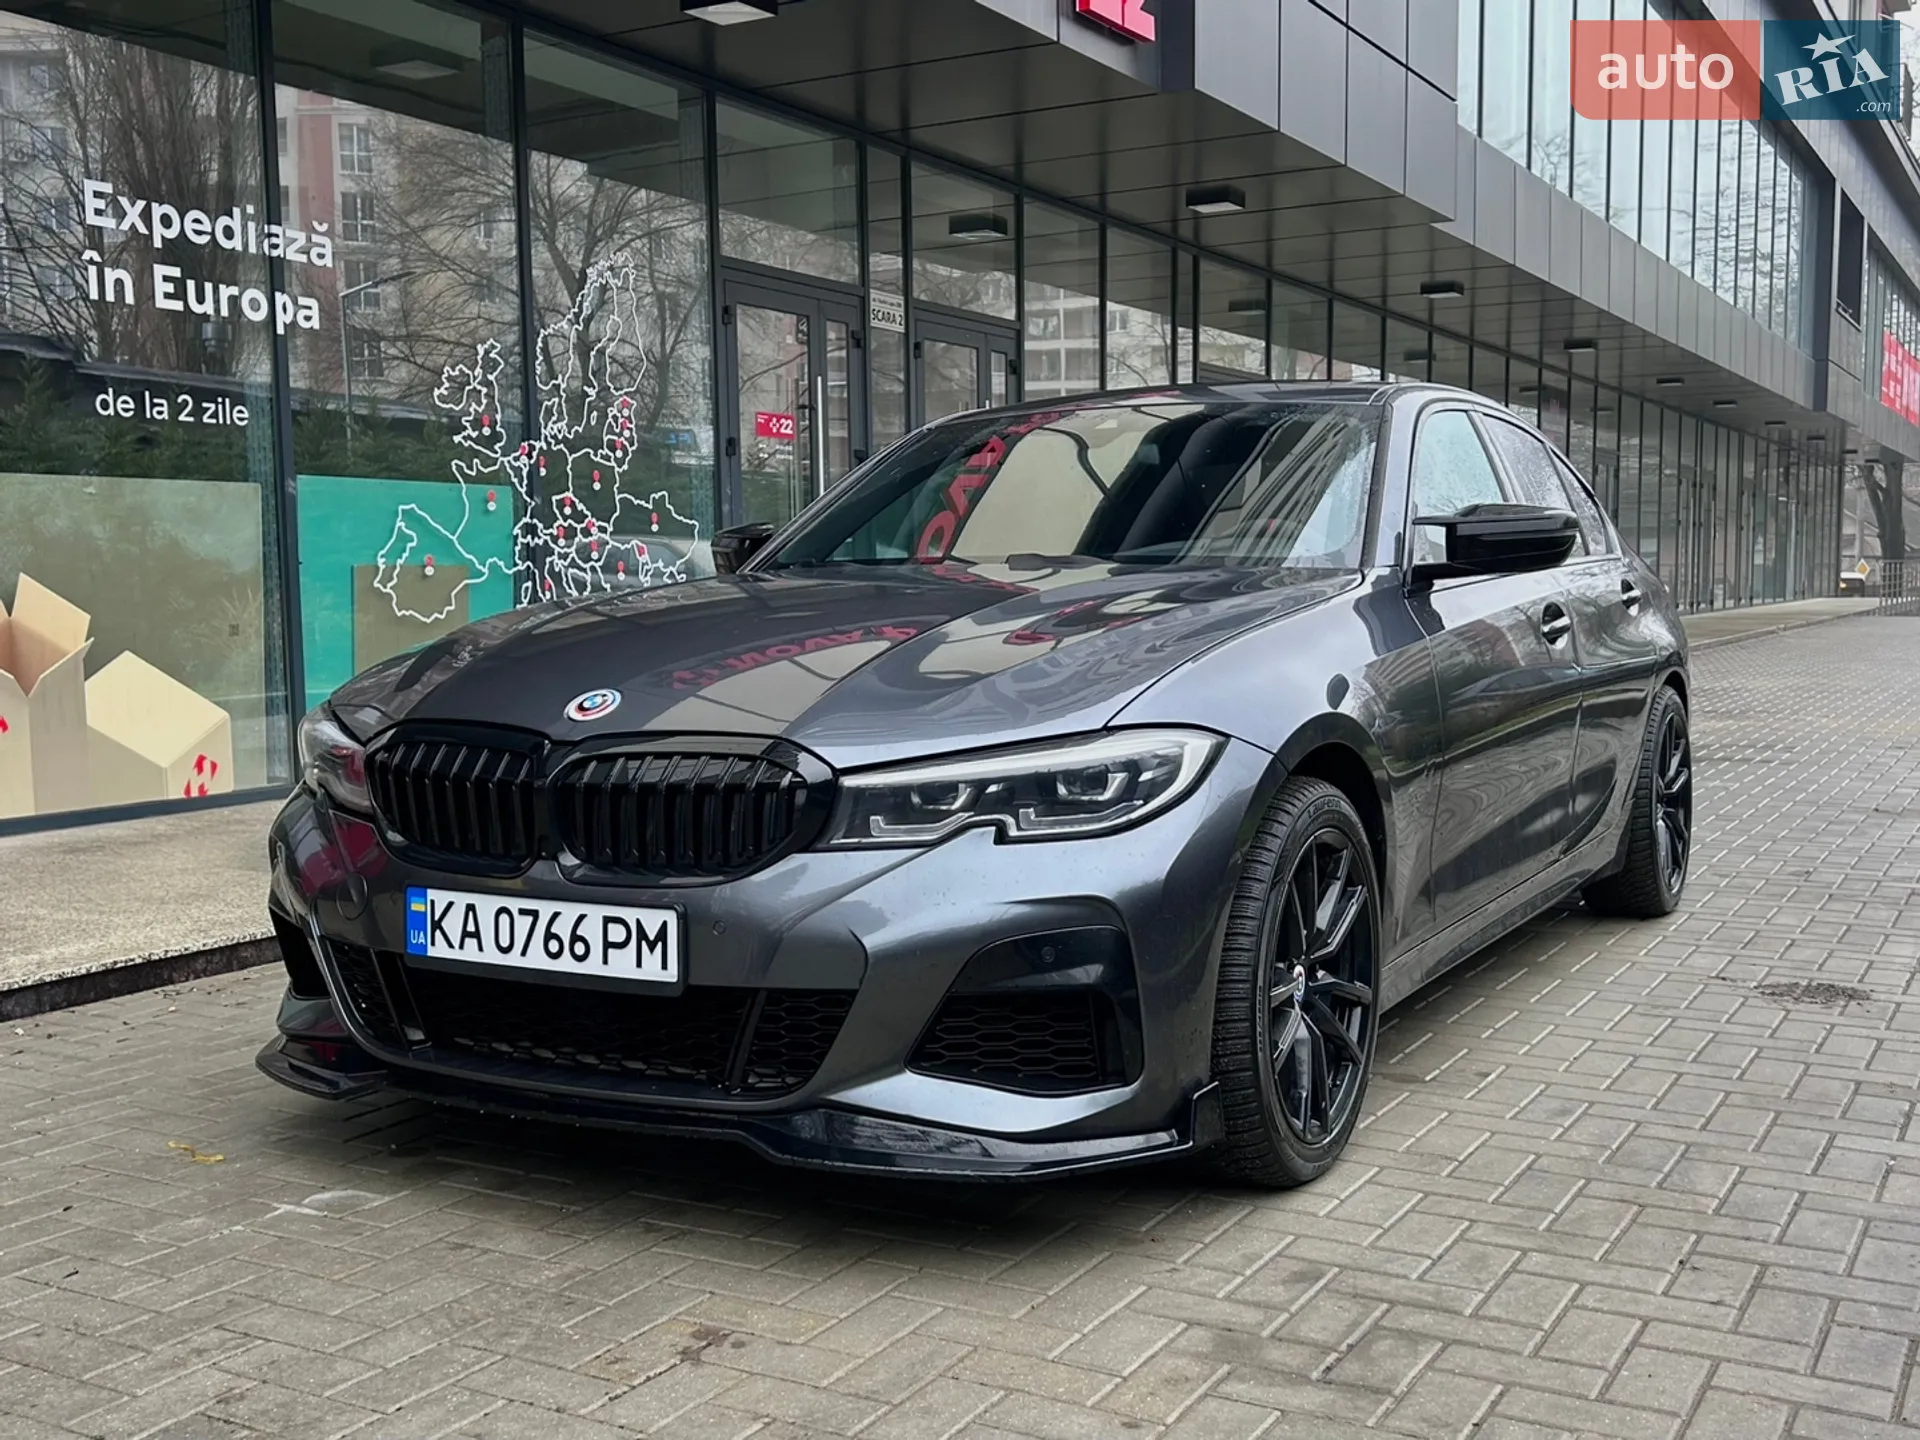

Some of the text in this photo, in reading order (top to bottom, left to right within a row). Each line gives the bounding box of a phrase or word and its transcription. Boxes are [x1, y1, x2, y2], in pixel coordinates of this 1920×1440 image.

[83, 178, 333, 268] Expediază
[81, 249, 320, 335] în Europa
[871, 308, 904, 327] SCARA 2
[95, 387, 249, 426] de la 2 zile
[779, 417, 794, 435] 22
[410, 929, 426, 946] UA
[429, 898, 669, 971] KA 0766 PM
